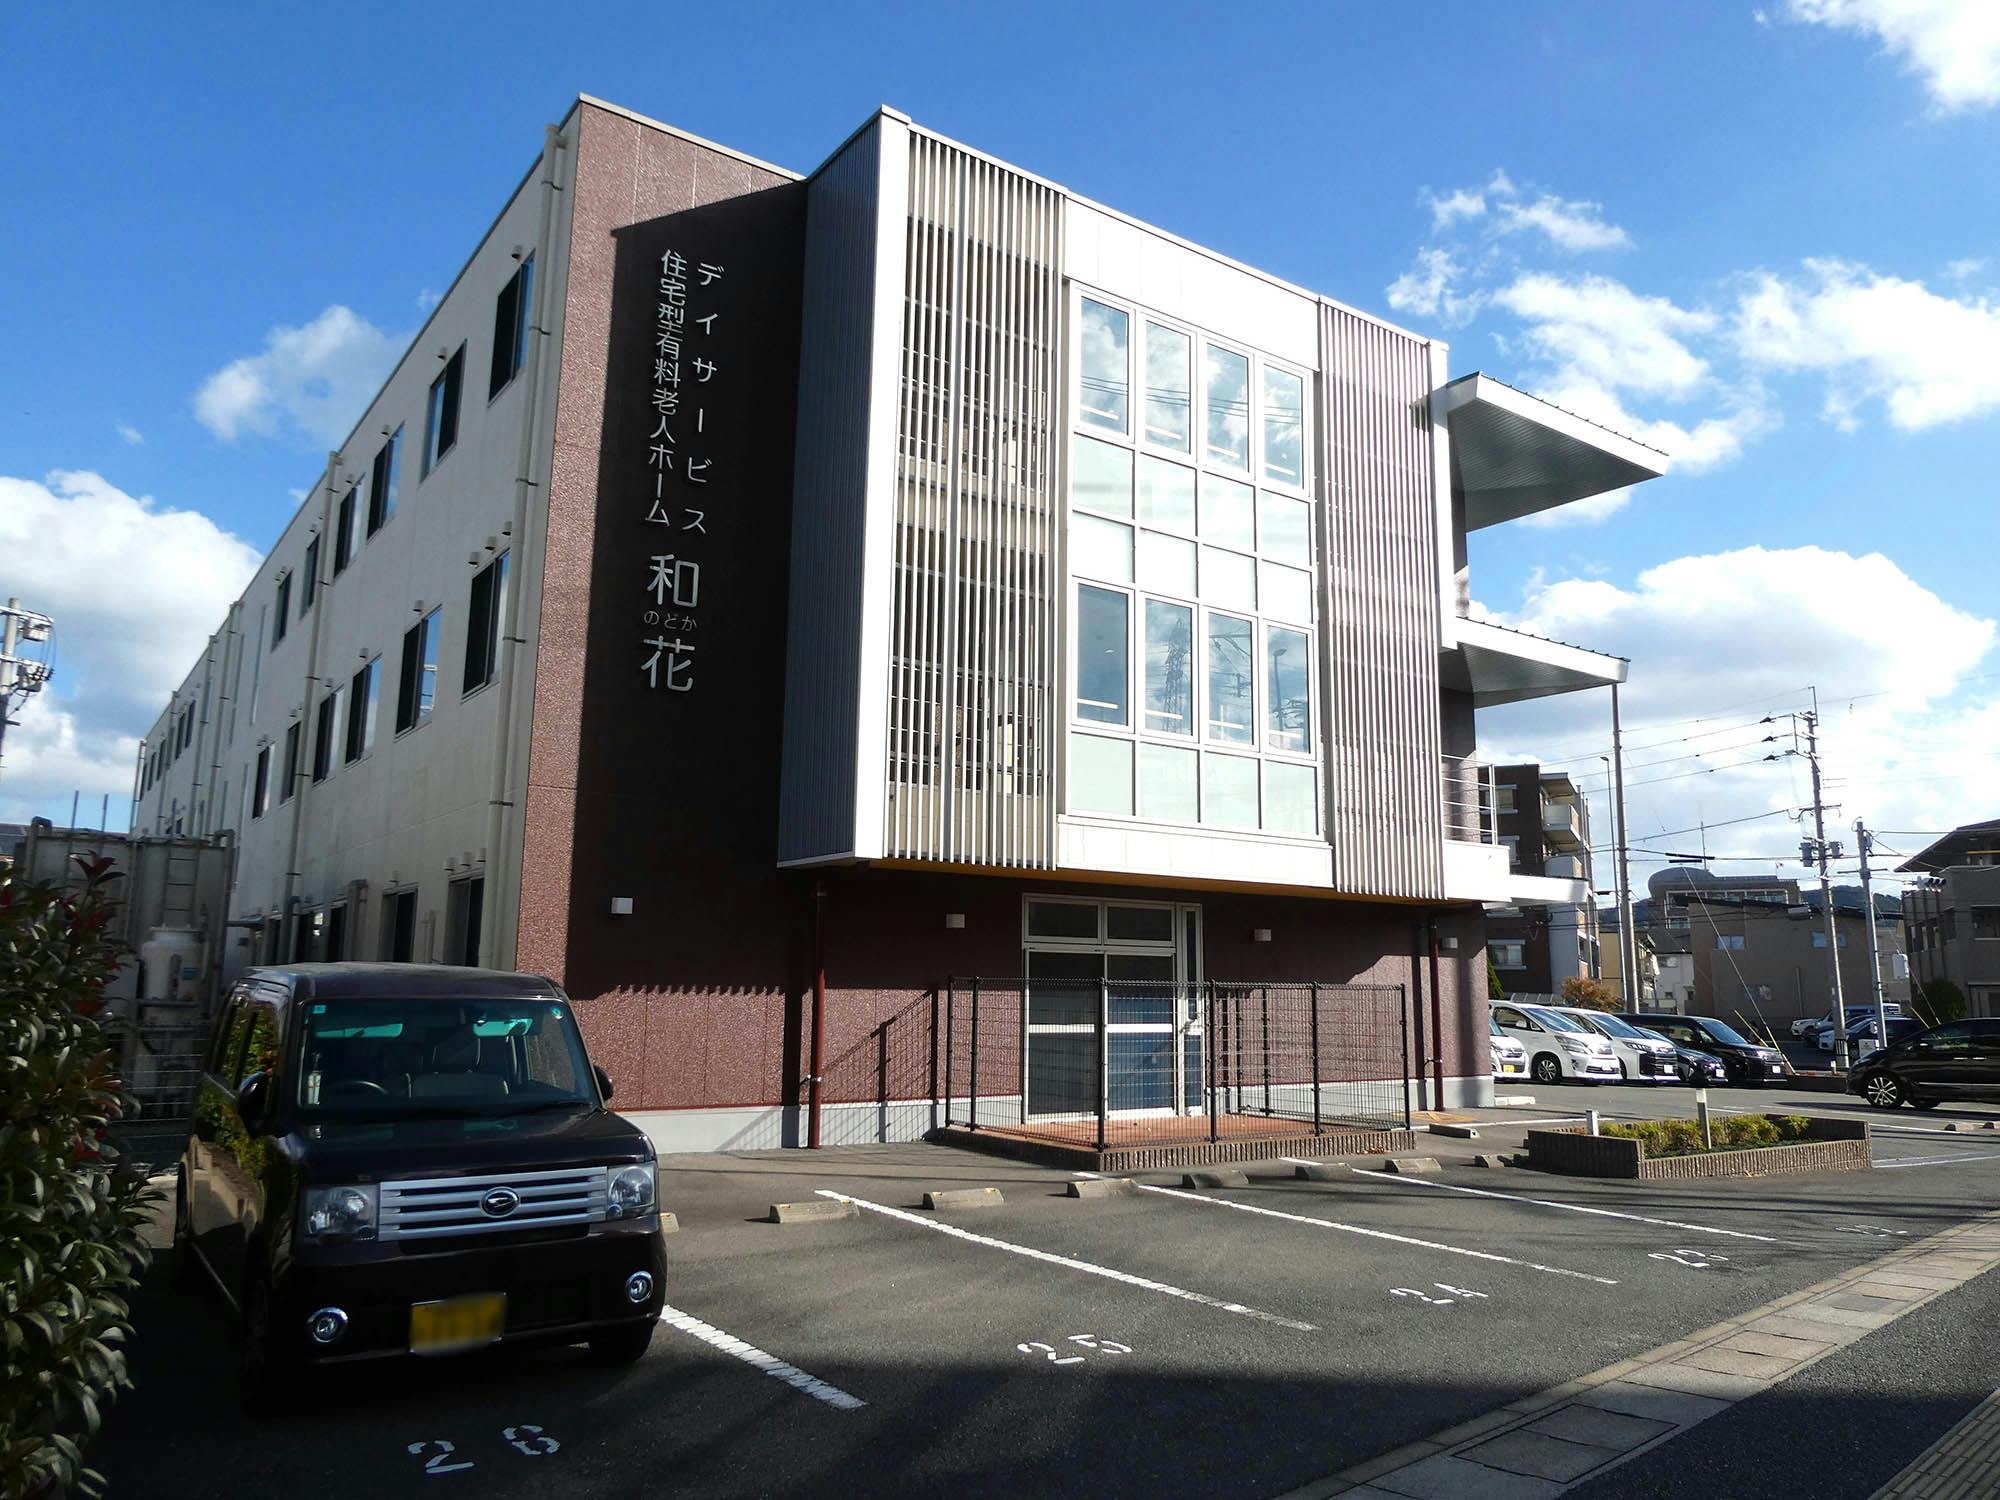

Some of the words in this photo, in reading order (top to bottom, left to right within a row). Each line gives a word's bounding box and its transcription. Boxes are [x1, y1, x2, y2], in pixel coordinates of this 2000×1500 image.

[645, 249, 688, 526] 住宅型有料老人ホーム
[643, 610, 698, 632] のどか
[1389, 1282, 1489, 1304] 24
[1016, 1334, 1133, 1365] 25
[407, 1425, 561, 1474] 26
